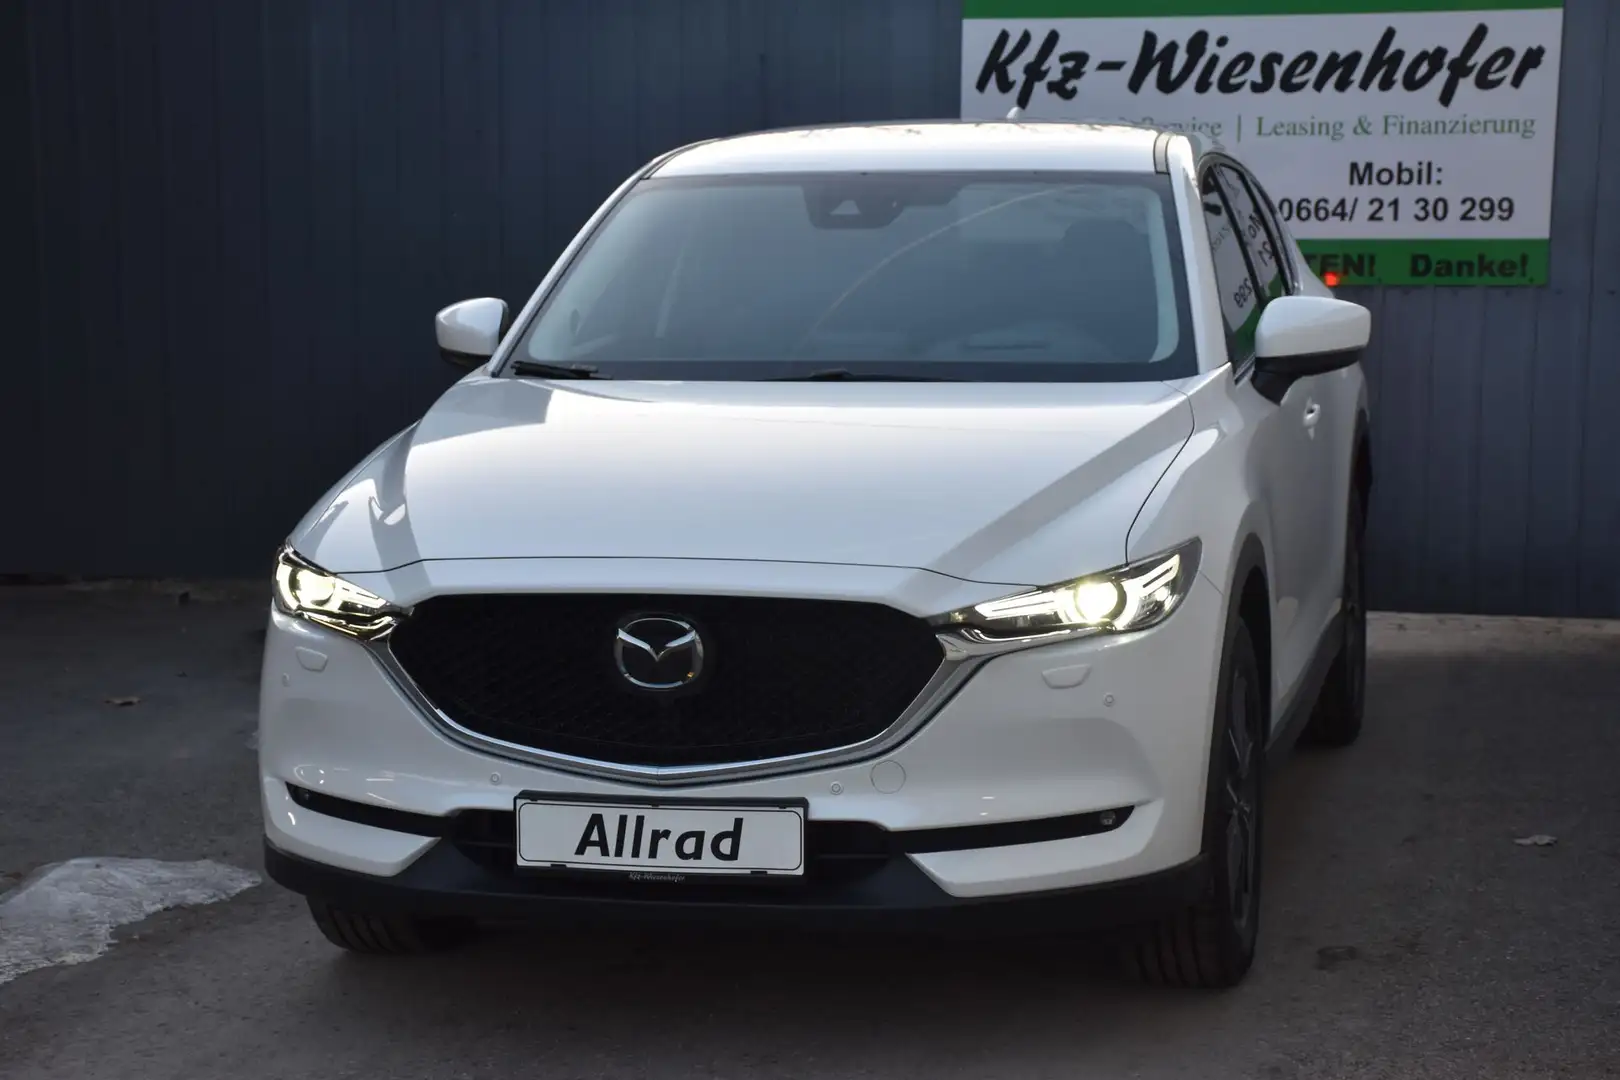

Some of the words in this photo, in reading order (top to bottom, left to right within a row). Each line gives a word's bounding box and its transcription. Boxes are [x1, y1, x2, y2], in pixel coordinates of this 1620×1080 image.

[975, 23, 1546, 110] Kfz-Wiesenhofer
[1256, 116, 1345, 141] Leasing
[1352, 115, 1373, 136] &
[1382, 114, 1537, 140] Finanzierung
[1349, 161, 1443, 186] Mobil:
[1278, 197, 1359, 222] 0664/
[1367, 197, 1400, 222] 21
[1413, 197, 1449, 222] 30
[1459, 197, 1515, 222] 299
[1410, 252, 1529, 278] Danke!
[574, 813, 744, 861] Allrad
